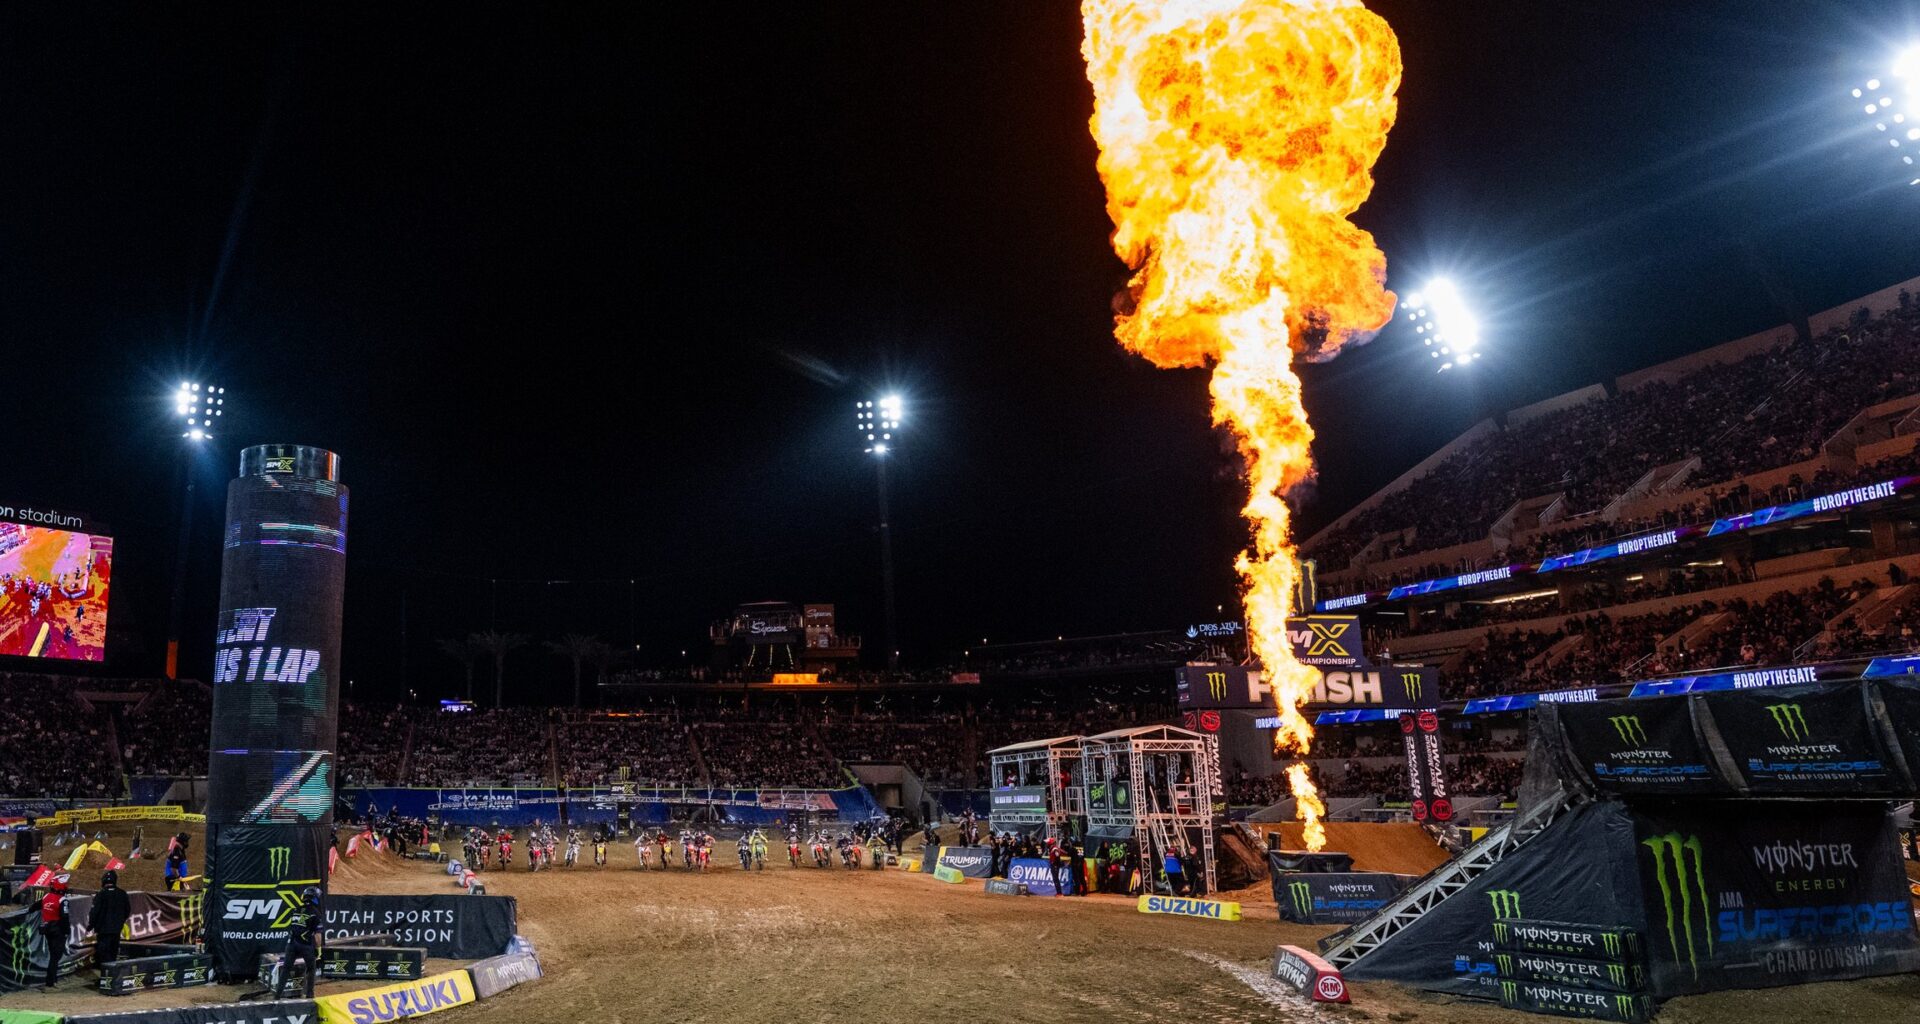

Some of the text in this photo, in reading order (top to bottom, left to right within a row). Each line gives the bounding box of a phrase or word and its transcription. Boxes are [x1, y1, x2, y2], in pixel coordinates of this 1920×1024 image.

[1813, 480, 1896, 512] #DROPTHEGATE
[19, 508, 82, 528] stadium
[1617, 530, 1678, 555] #DROPTHEGATE
[1457, 566, 1512, 586] #DROPTHEGATE
[1325, 594, 1367, 610] #DROPTHEGATE
[1199, 623, 1218, 632] DIOS
[246, 647, 263, 683] 1
[263, 647, 320, 683] LAP
[1299, 657, 1357, 665] HAMPIONSHIP
[1733, 666, 1817, 689] #DROPTHEGATE
[1538, 688, 1598, 702] #DROPTHEGATE
[1610, 749, 1672, 760] MONSTER
[1767, 744, 1841, 755] MONSTER
[1595, 765, 1710, 775] SUPERCROSS
[1748, 761, 1881, 772] SUPERCROSS
[945, 855, 982, 868] TRIUMPH
[1753, 839, 1858, 874] MONSTER
[1329, 883, 1375, 893] MONSTER
[1775, 878, 1848, 892] ENERGY
[1147, 897, 1221, 918] SUZUKI
[1719, 891, 1744, 908] AMA
[325, 910, 454, 924] UTAH SPORTS
[1718, 901, 1909, 942] SUPERCROSS
[222, 931, 254, 940] WORLD
[1514, 926, 1595, 946] MONSTER
[1527, 942, 1584, 953] ENERGY
[1519, 957, 1601, 977] MONSTER
[1766, 944, 1877, 974] CHAMPIONSHIP
[1533, 973, 1589, 984] ENERGY
[347, 978, 462, 1024] SUZUKI
[1524, 986, 1608, 1008] MONSTER
[1539, 1001, 1596, 1015] ENERGY
